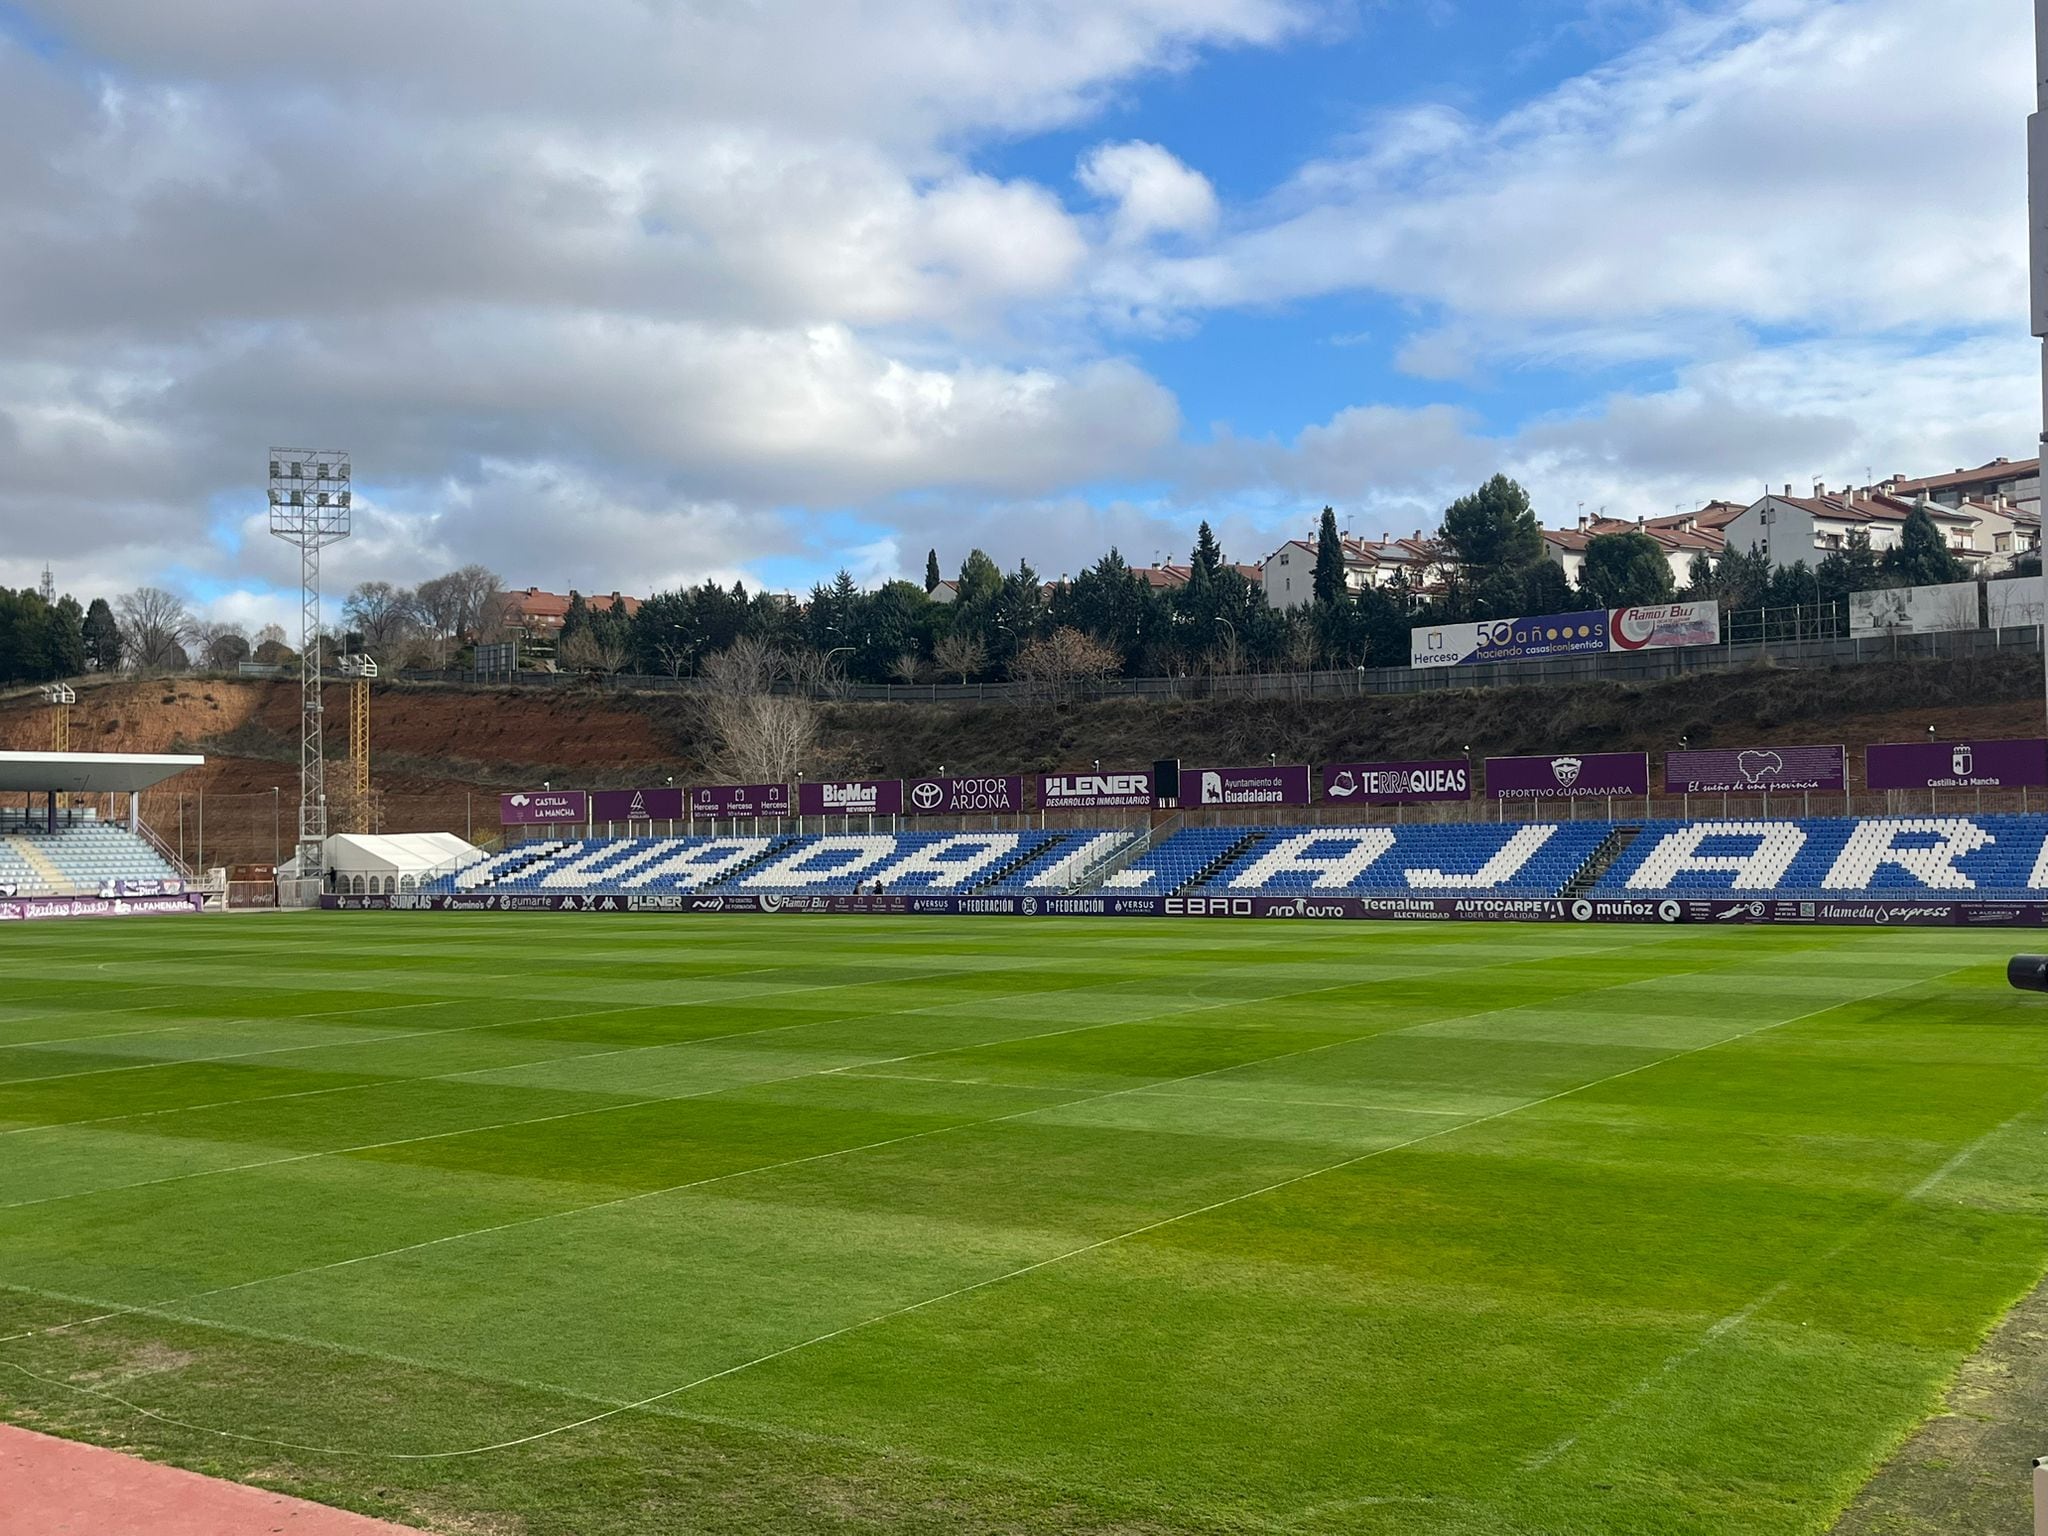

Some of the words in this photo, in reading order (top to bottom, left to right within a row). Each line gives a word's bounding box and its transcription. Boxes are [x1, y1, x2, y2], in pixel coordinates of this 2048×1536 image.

[1628, 609, 1667, 622] Ramos
[1670, 606, 1694, 617] Bus
[1476, 622, 1512, 648] 50
[1414, 653, 1459, 665] Hercesa
[1476, 647, 1523, 660] haciendo
[952, 778, 1007, 795] MOTOR
[1060, 775, 1149, 796] LENER
[1224, 777, 1272, 789] Ayuntamiento
[1273, 777, 1283, 787] de
[1361, 769, 1467, 795] TERRAQUEAS
[1688, 780, 1700, 793] El
[1702, 781, 1731, 792] sueño
[1732, 780, 1744, 791] de
[1746, 782, 1768, 791] una
[1769, 778, 1818, 793] provincia
[1927, 778, 1967, 787] Castilla-La
[1970, 777, 1999, 787] Mancha
[823, 784, 877, 807] BigMat
[1224, 789, 1283, 804] Guadalajara
[1498, 788, 1554, 799] DEPORTIVO
[1556, 785, 1632, 797] GUADALAJARA
[761, 801, 788, 810] Hercesa
[950, 794, 1010, 809] ARJONA
[1046, 797, 1095, 807] DESARROLLOS
[1096, 795, 1149, 806] INMOBILIARIOS
[535, 809, 543, 818] LA
[545, 808, 575, 818] MANCHA
[511, 896, 551, 909] gumarfe
[639, 896, 682, 907] LENER
[781, 897, 810, 908] Ramos
[812, 897, 830, 908] Bus
[920, 900, 949, 908] VERSUS
[967, 898, 1013, 913] FEDERACIÓN
[1055, 898, 1104, 913] FEDERACIÓN
[1122, 901, 1154, 909] VERSUS
[1164, 899, 1251, 915] EBRO
[1361, 898, 1434, 911] Tecnalum
[1455, 900, 1542, 912] AUTOCARPE
[1596, 900, 1654, 916] muñoz
[1394, 911, 1450, 919] ELECTRICIDAD
[1488, 911, 1499, 919] DE
[1818, 904, 1875, 918] Alameda
[1889, 905, 1951, 922] express
